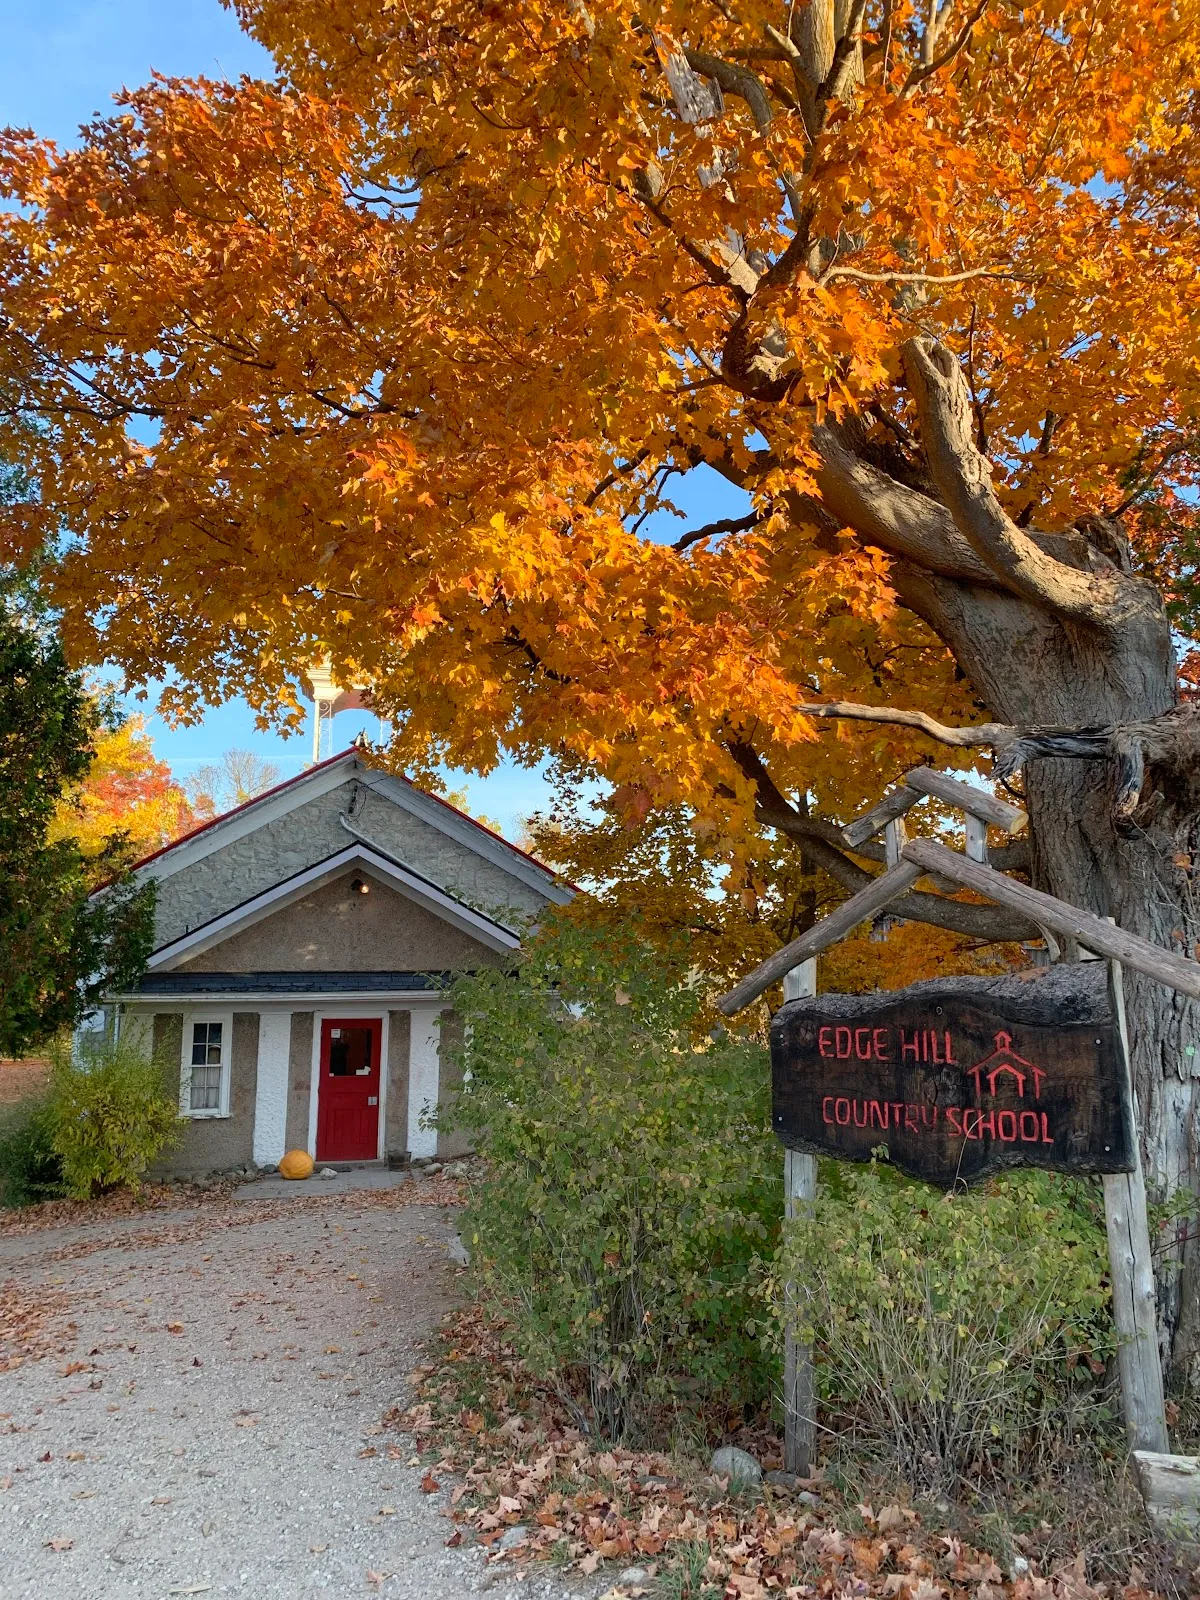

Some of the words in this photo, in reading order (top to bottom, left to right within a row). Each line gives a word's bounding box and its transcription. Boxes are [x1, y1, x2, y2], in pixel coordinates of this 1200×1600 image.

[818, 1026, 889, 1061] EDGE
[901, 1029, 957, 1065] HILL
[945, 1107, 1055, 1143] SCHOOL
